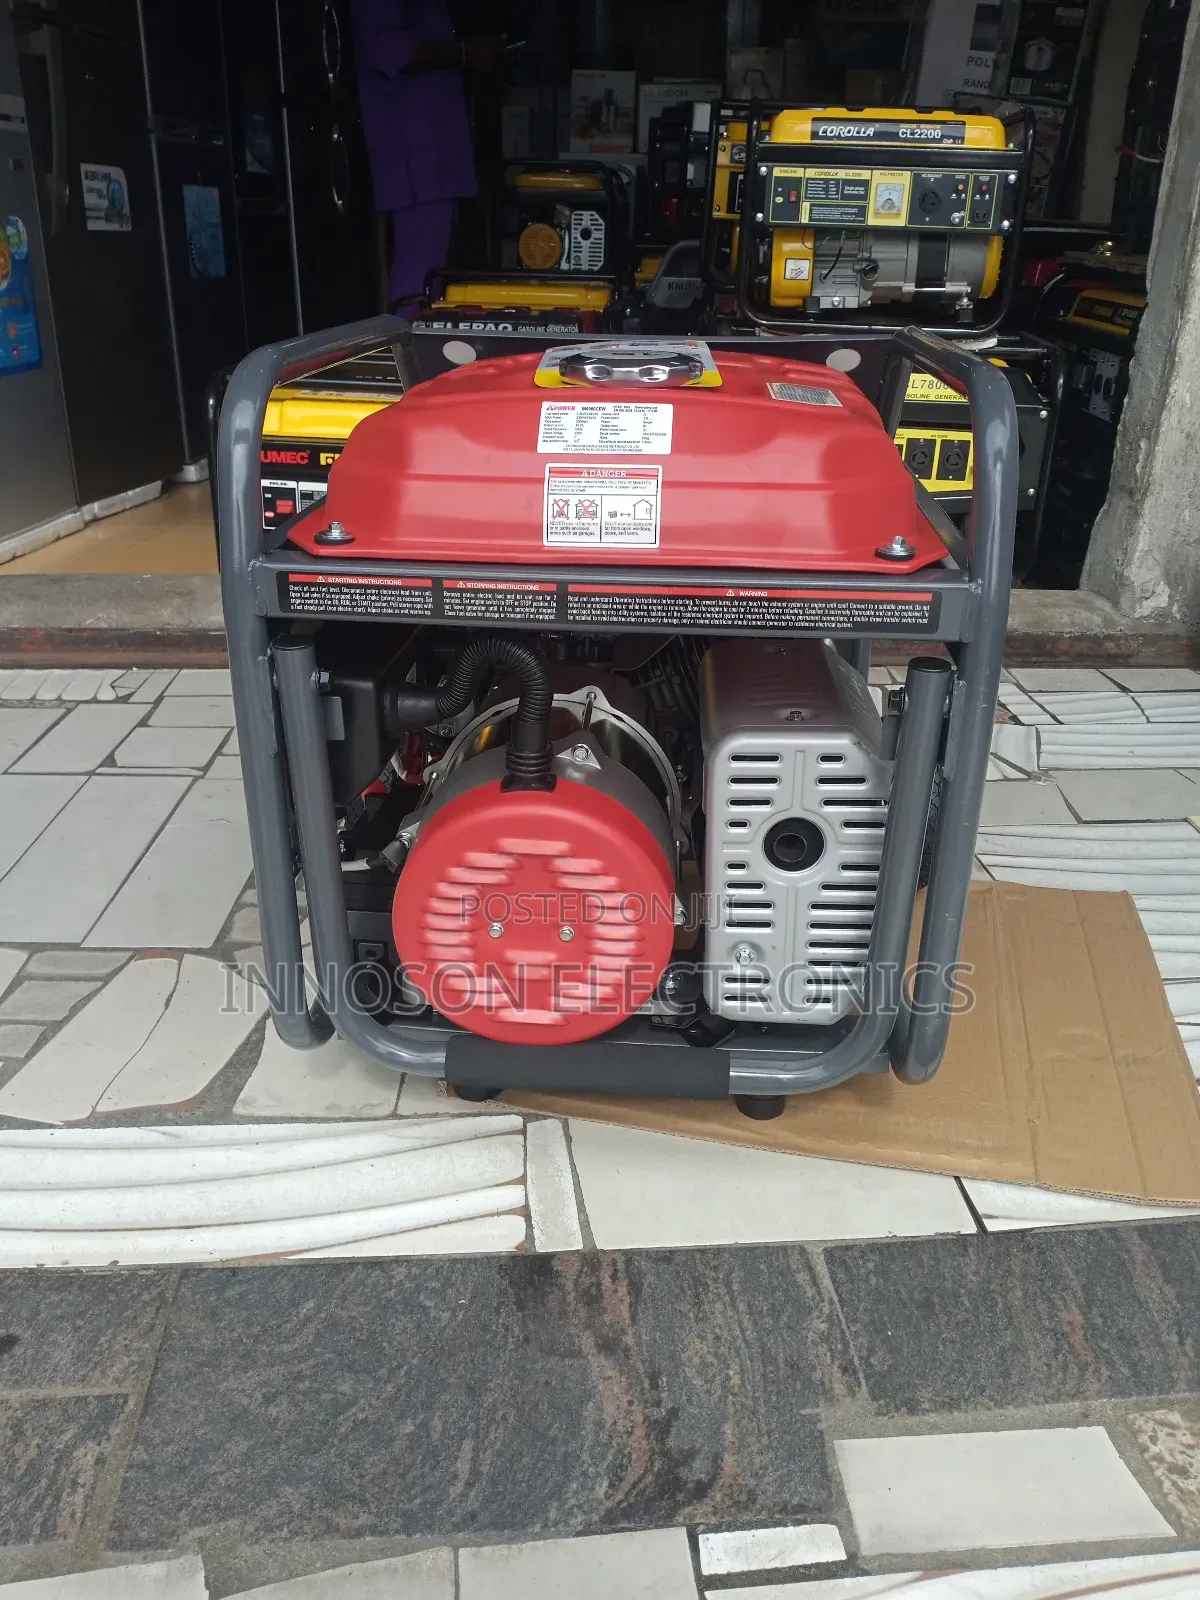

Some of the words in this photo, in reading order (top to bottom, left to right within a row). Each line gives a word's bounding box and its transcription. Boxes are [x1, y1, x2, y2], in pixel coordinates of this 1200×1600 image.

[818, 125, 875, 137] COROLLA
[899, 128, 942, 139] CL2200
[546, 325, 579, 334] GENERATOR
[908, 379, 950, 390] L780
